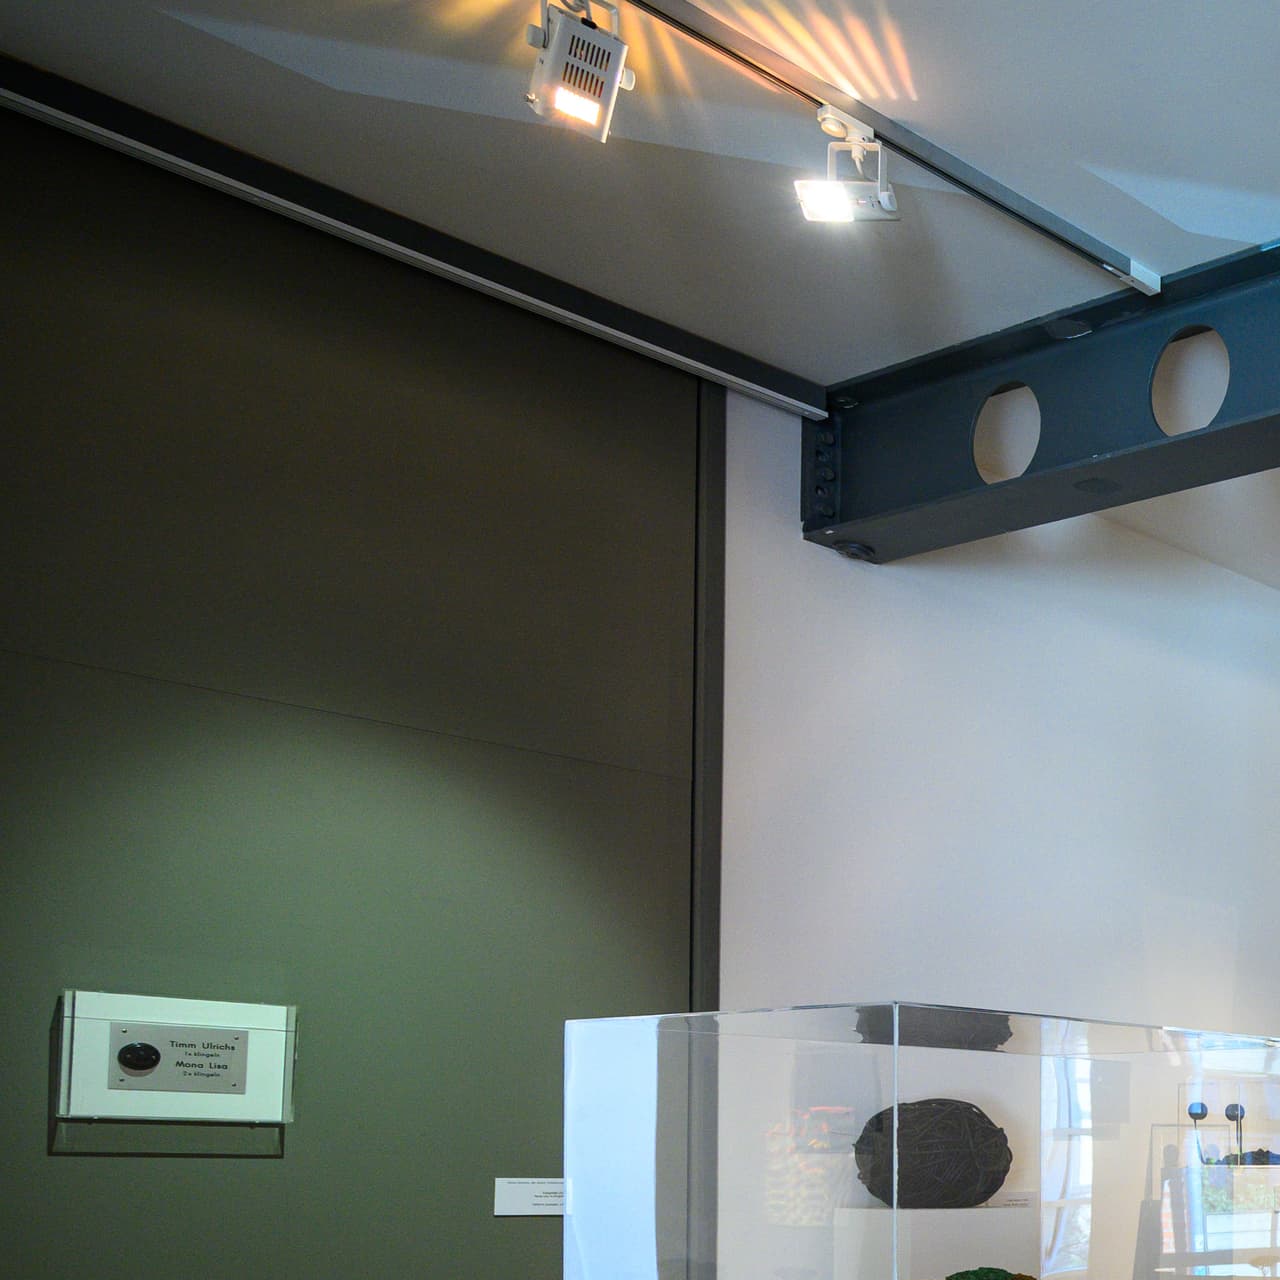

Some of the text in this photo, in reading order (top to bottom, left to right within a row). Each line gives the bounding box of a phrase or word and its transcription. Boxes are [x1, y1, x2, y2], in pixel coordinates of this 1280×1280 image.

[169, 1040, 235, 1051] Timm Ulrichs
[176, 1060, 228, 1070] Mona Lisa
